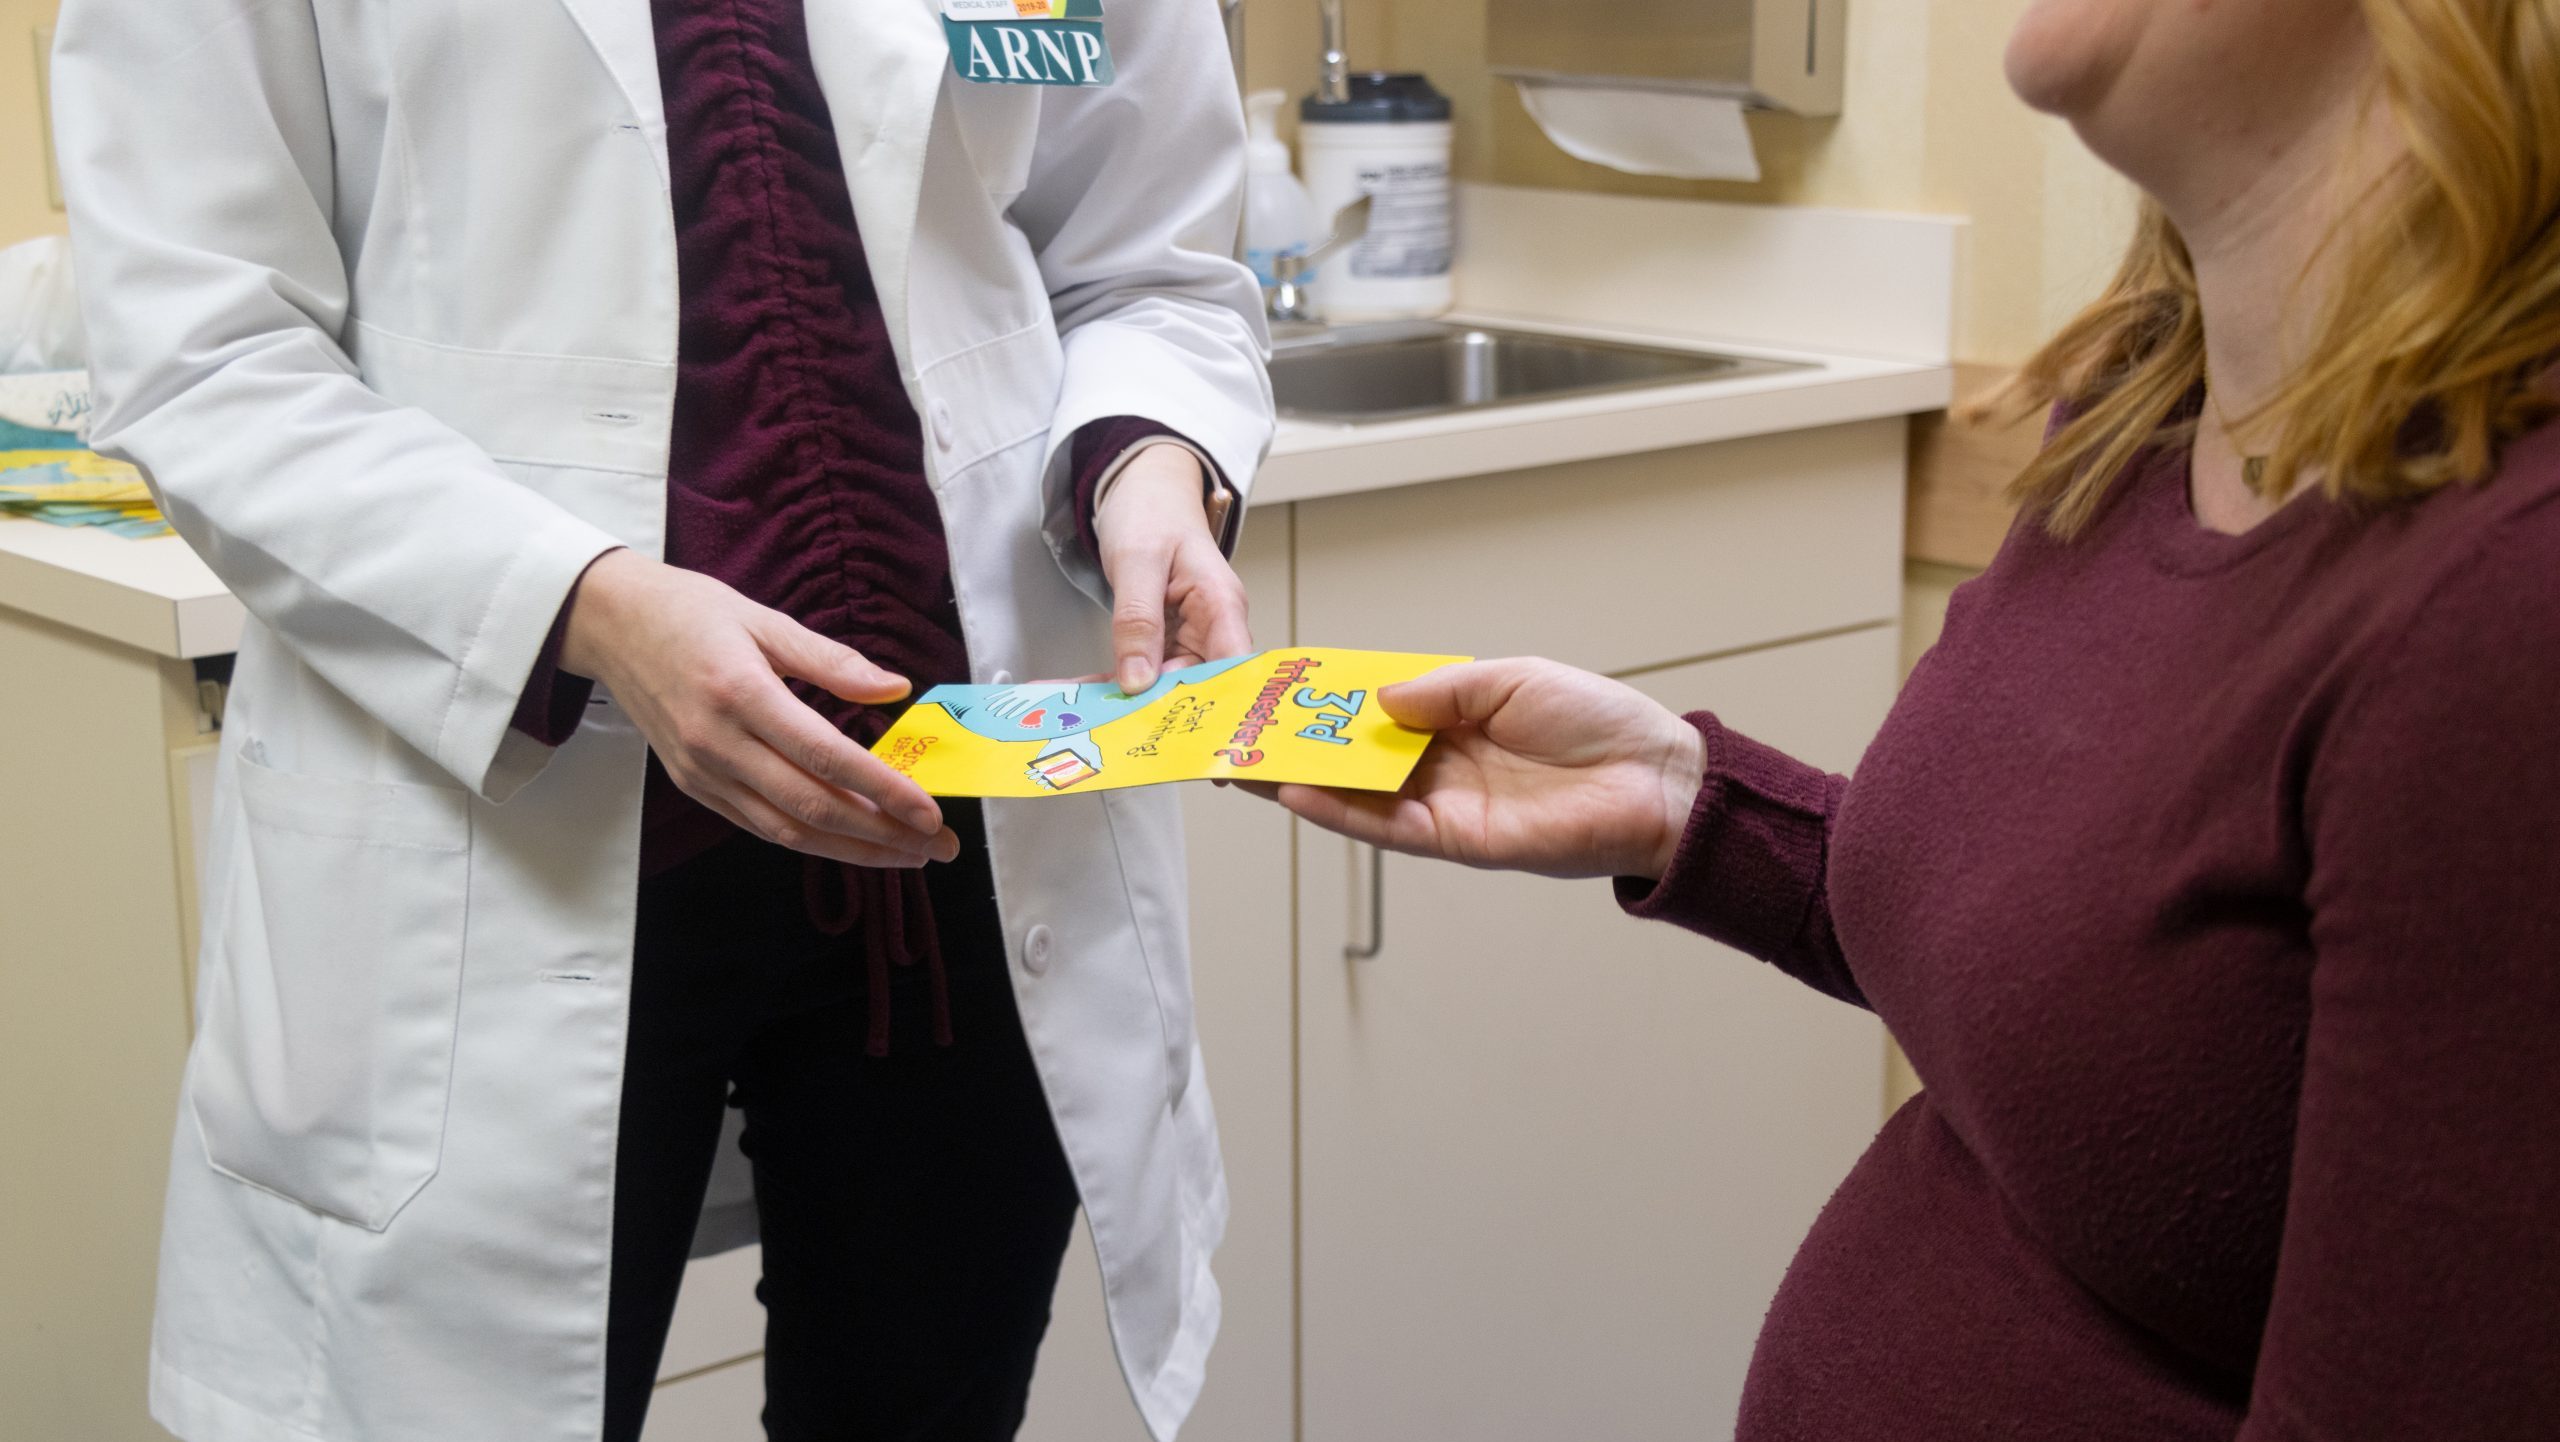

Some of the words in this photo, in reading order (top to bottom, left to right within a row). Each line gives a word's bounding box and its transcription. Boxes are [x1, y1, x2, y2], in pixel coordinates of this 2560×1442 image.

[967, 25, 1101, 83] ARNP
[1126, 695, 1197, 758] Counting!
[1176, 700, 1216, 735] Start
[1292, 686, 1367, 746] 3rd
